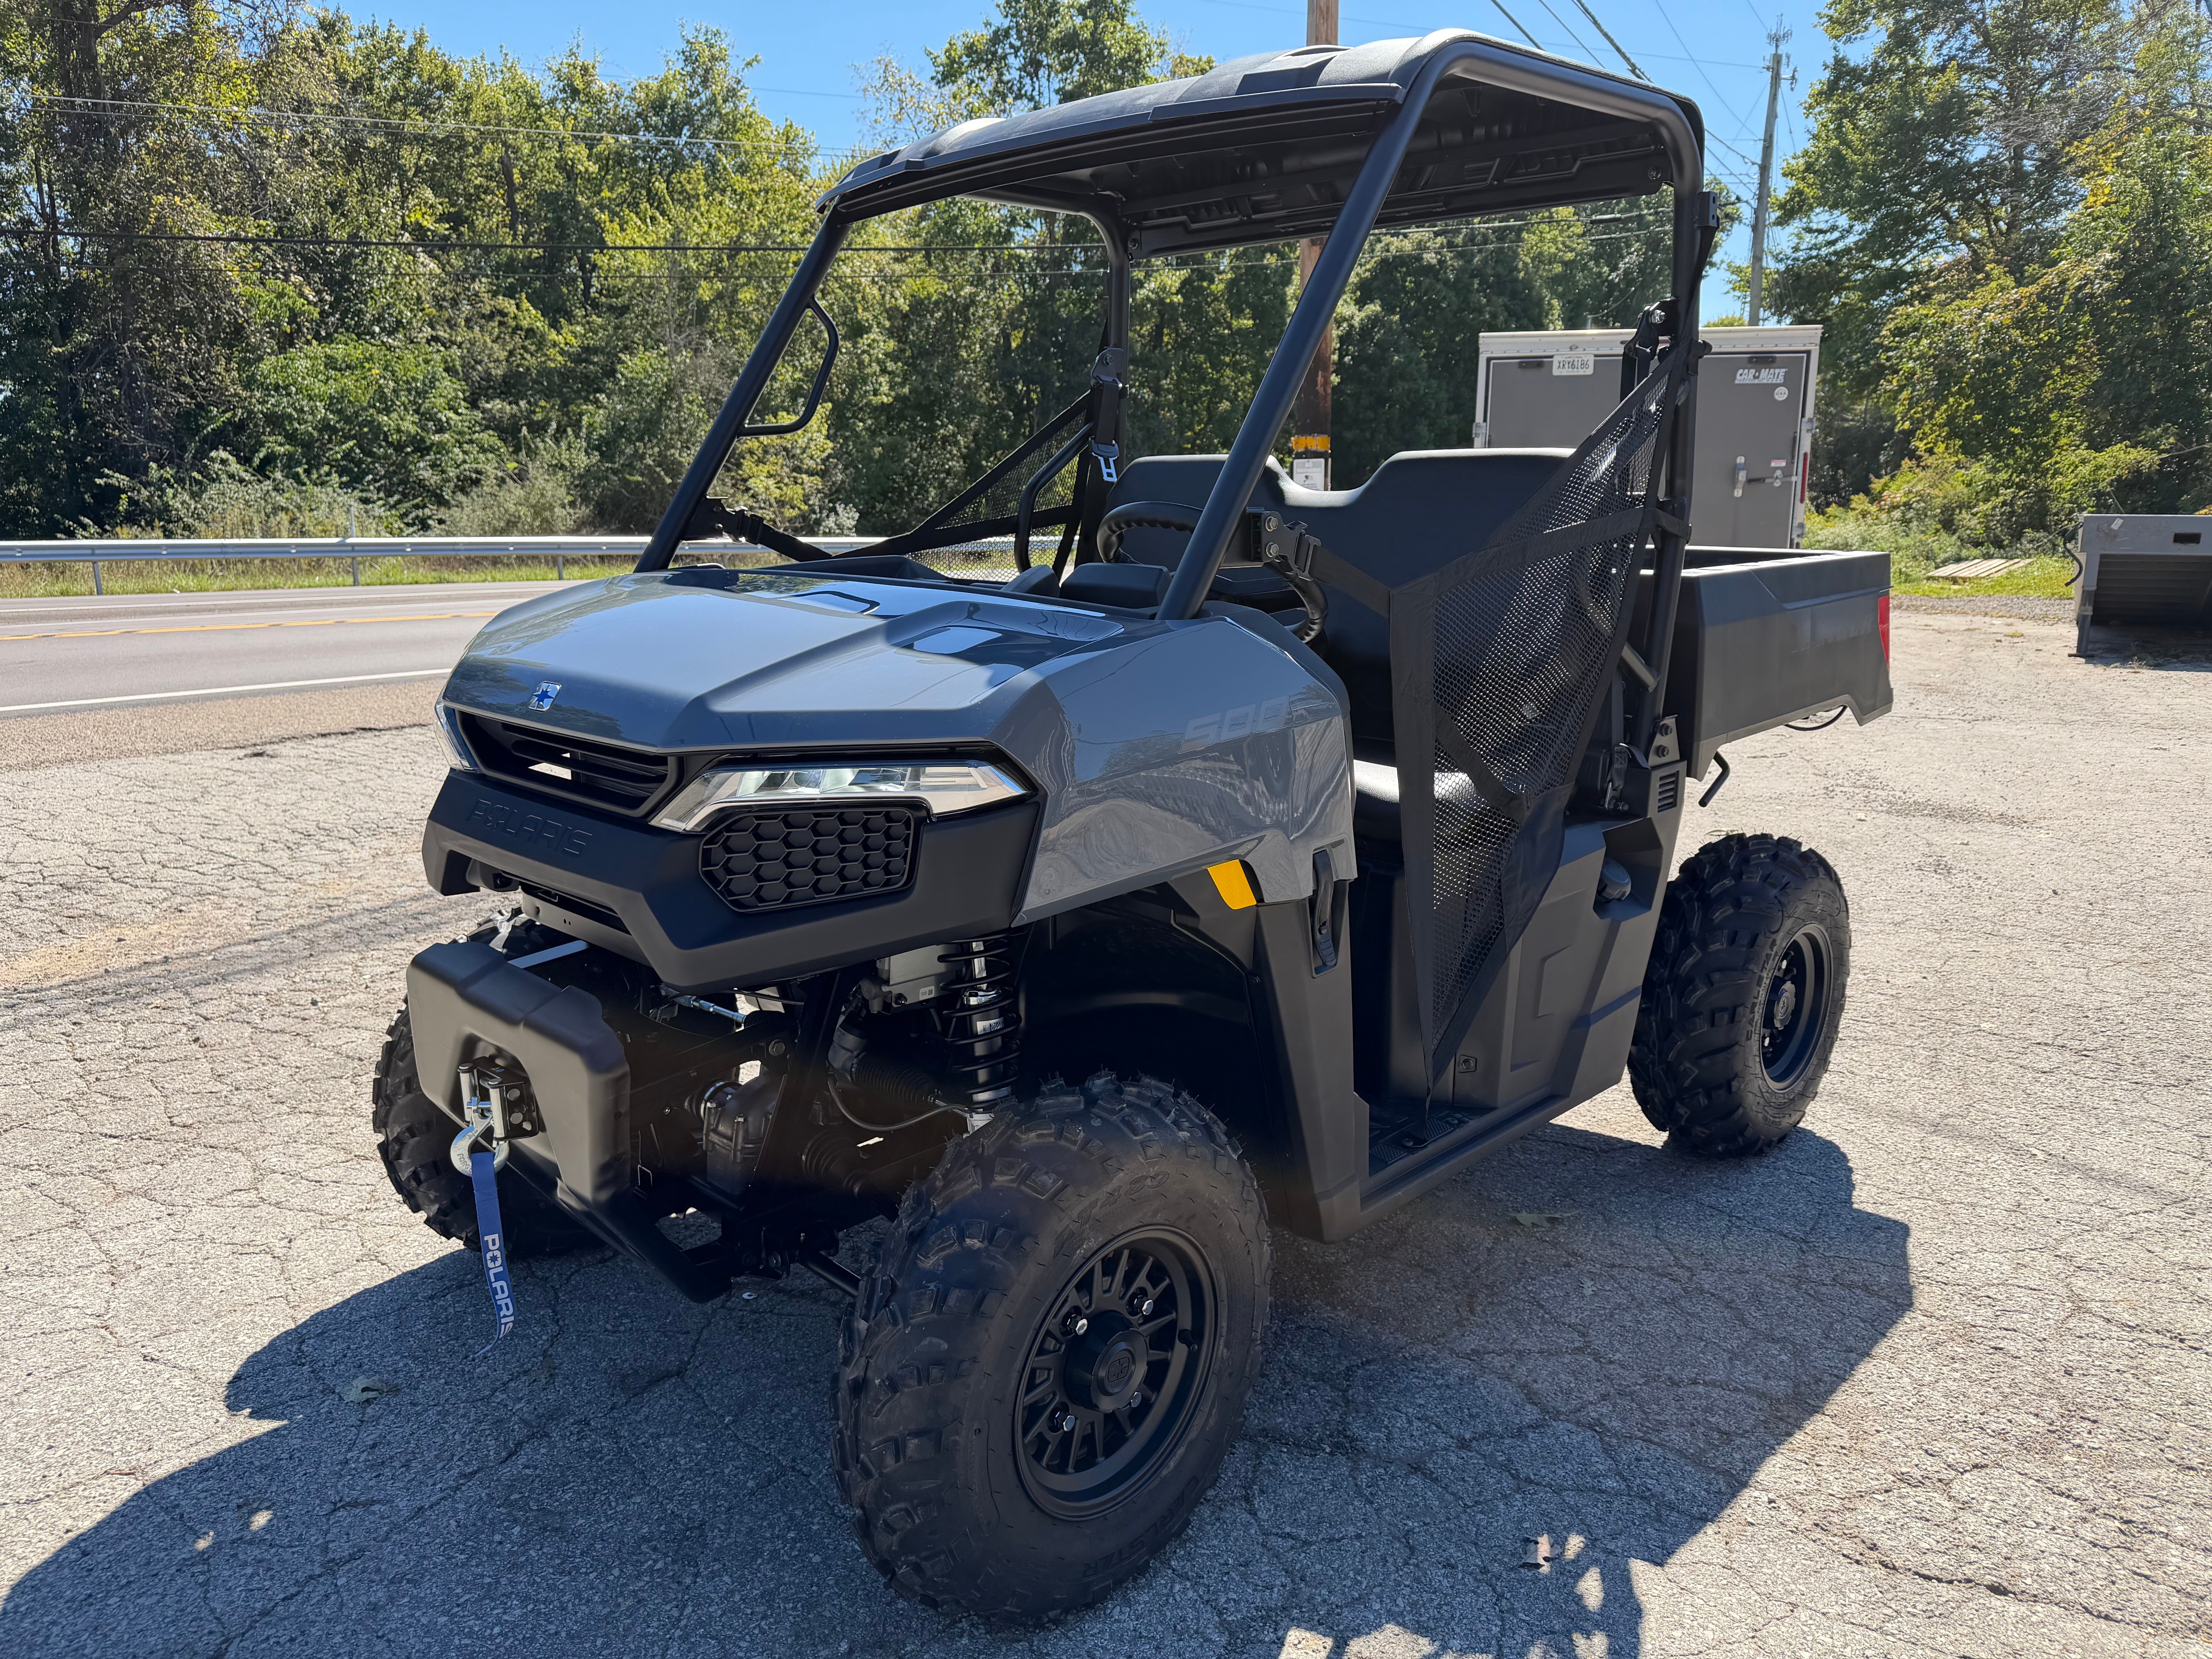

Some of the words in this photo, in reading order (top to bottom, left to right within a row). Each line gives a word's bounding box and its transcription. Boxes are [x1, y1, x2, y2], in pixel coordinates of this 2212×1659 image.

[1179, 694, 1290, 754] 500
[466, 799, 592, 857] POLARIS
[1746, 938, 1777, 1041] CARLSTAR
[484, 1233, 514, 1338] POLARIS
[1084, 1475, 1199, 1576] CARLSTAR
